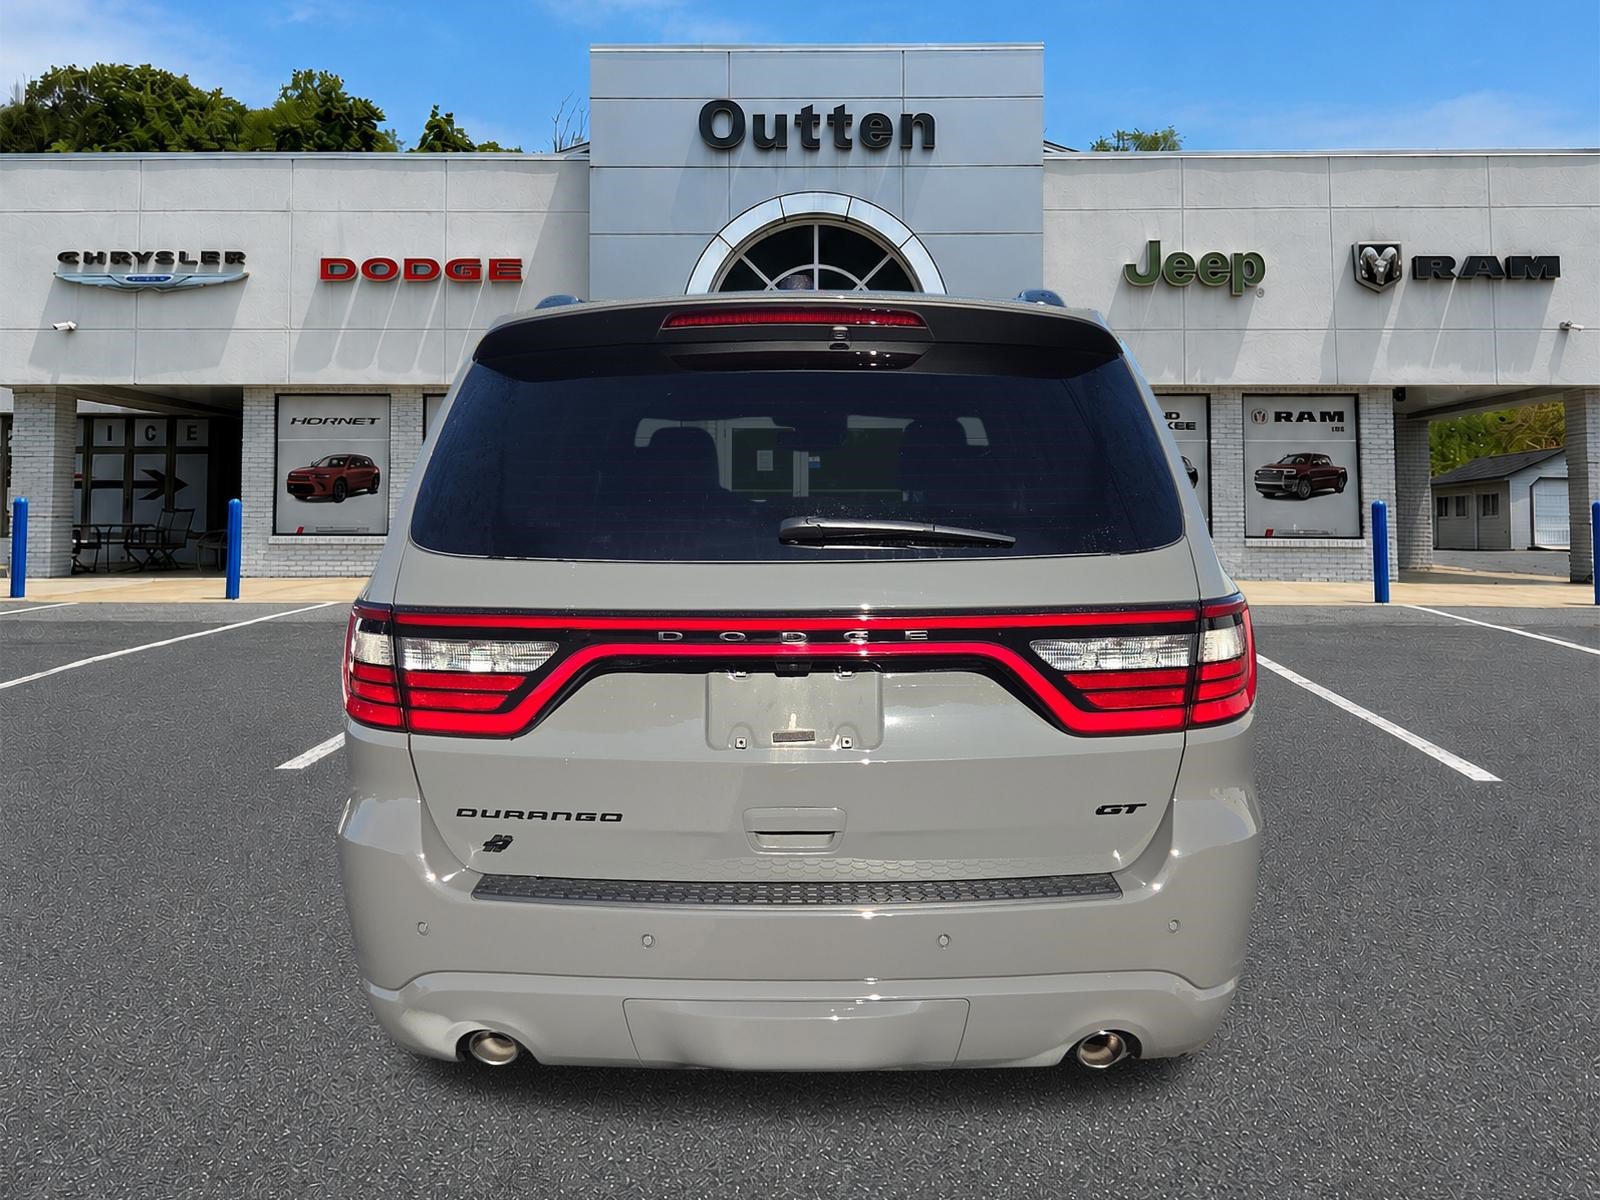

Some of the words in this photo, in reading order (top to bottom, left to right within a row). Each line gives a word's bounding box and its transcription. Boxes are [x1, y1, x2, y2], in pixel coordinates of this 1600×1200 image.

[699, 99, 936, 151] Outten
[57, 250, 247, 266] CHRYSLER
[320, 257, 524, 282] DODGE
[1123, 239, 1266, 296] Jeep
[1411, 255, 1561, 280] RAM
[290, 417, 381, 426] HORNET
[1274, 411, 1345, 423] RAM
[658, 630, 930, 645] DODGE
[456, 808, 624, 823] DURANGO
[1095, 803, 1147, 815] GT
